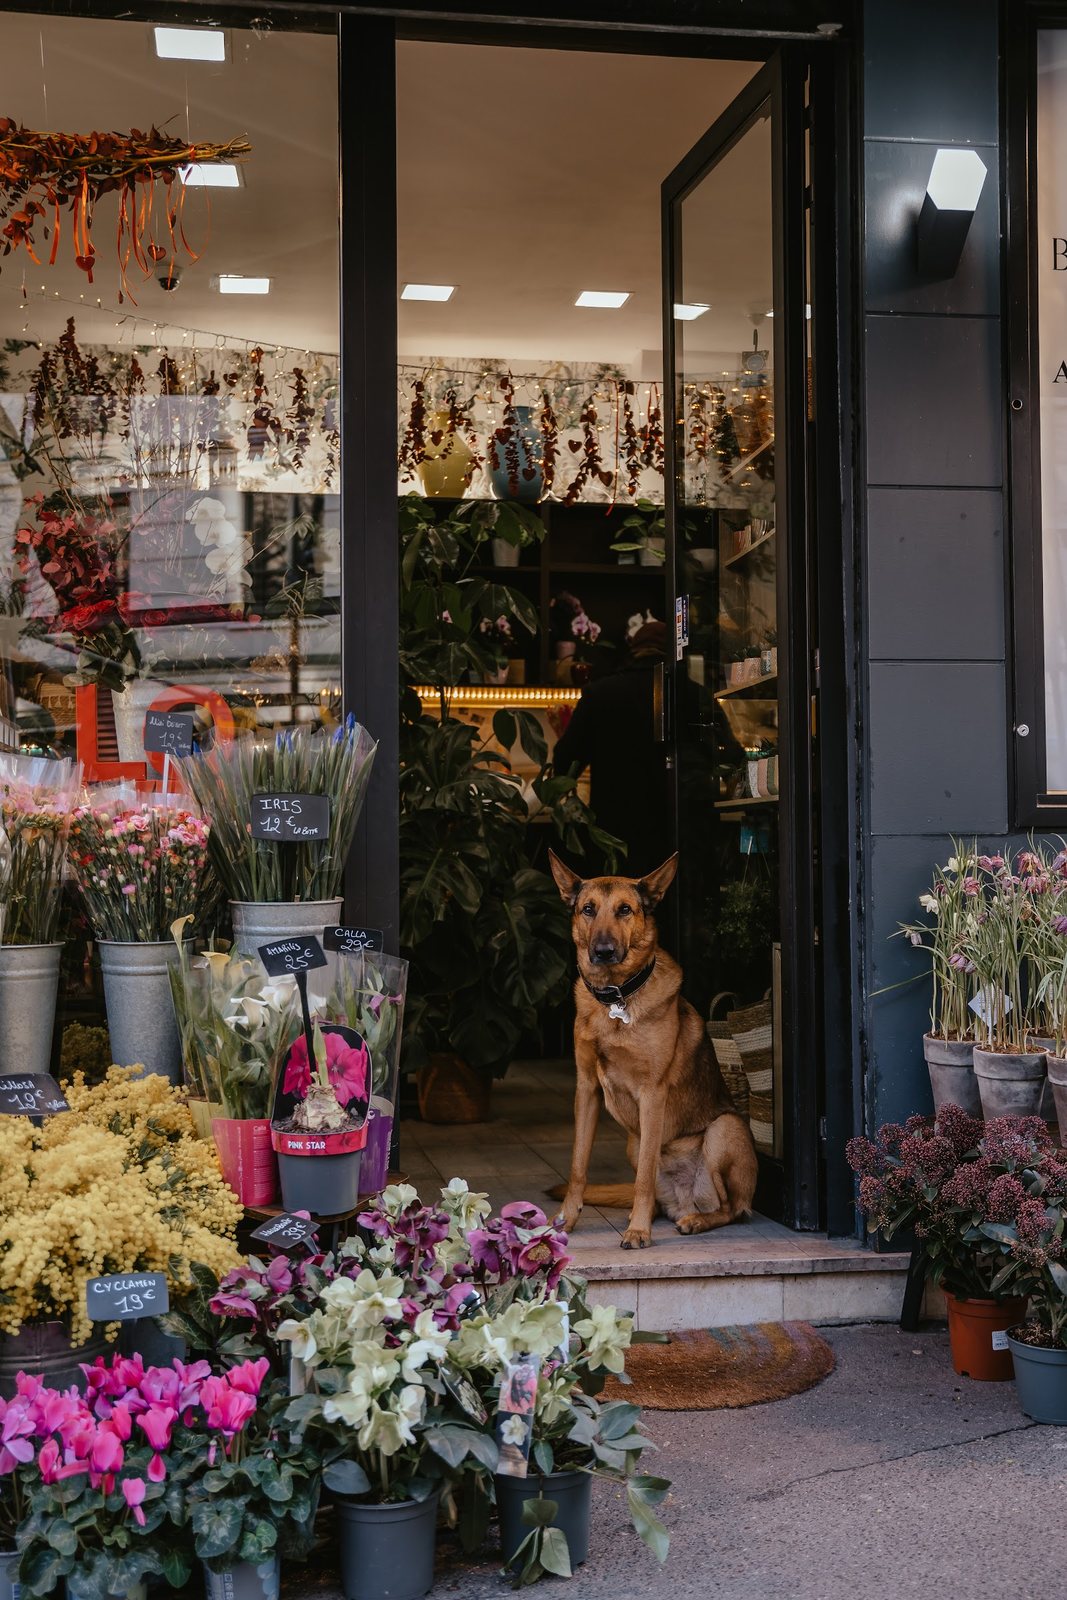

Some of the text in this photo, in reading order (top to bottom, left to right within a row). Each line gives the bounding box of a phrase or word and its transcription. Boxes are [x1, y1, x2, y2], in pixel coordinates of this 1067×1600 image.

[259, 798, 303, 814] IRIS
[334, 928, 367, 939] CALLA
[287, 1140, 326, 1150] PINK STAR
[93, 1279, 156, 1293] CYCLAMEN
